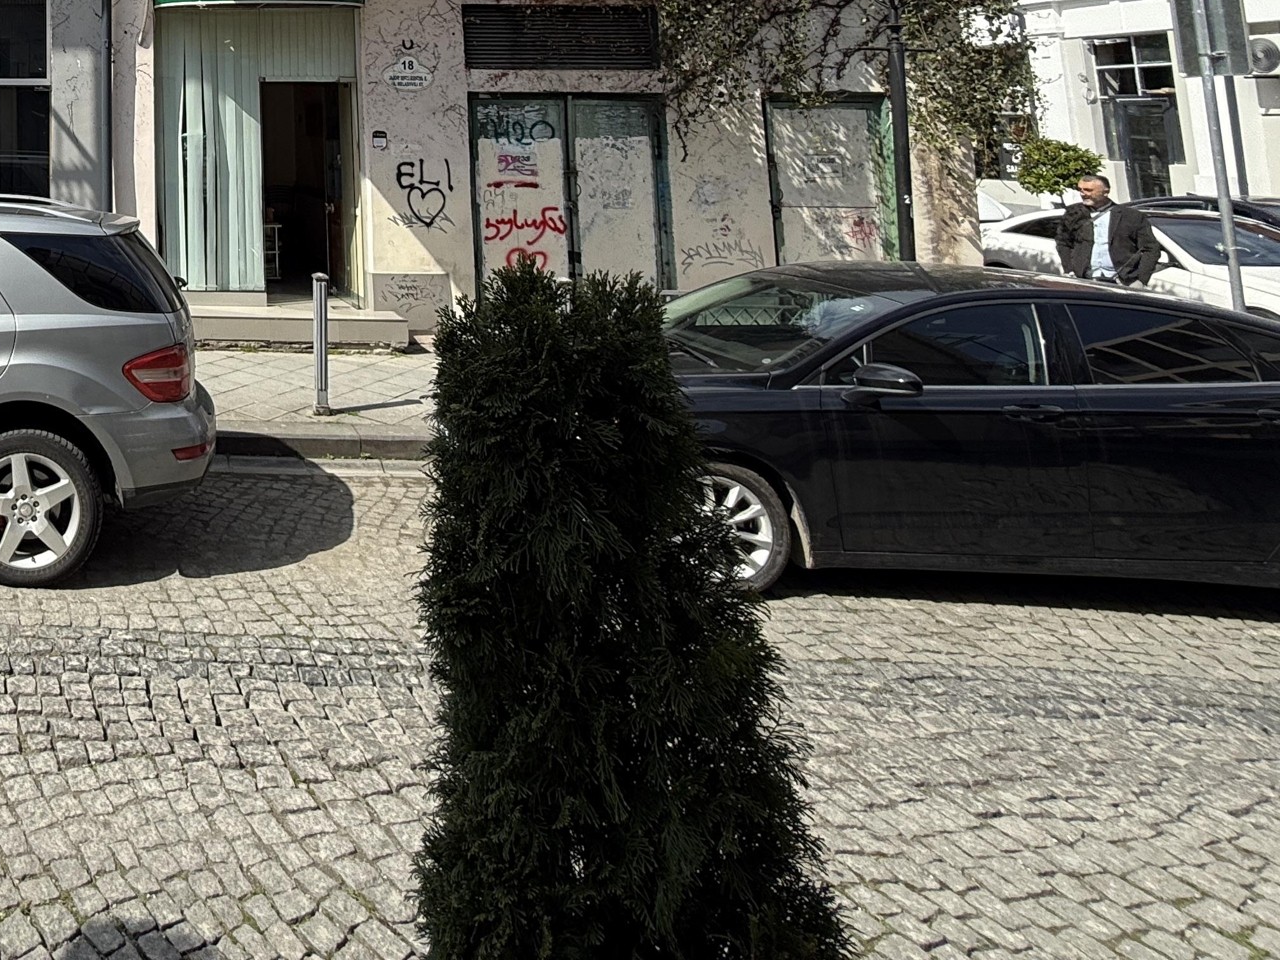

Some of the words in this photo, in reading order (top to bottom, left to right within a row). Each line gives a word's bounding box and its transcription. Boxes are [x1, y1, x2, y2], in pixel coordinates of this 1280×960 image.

[401, 60, 414, 71] 18
[396, 158, 454, 192] ELI
[903, 194, 911, 204] 2
